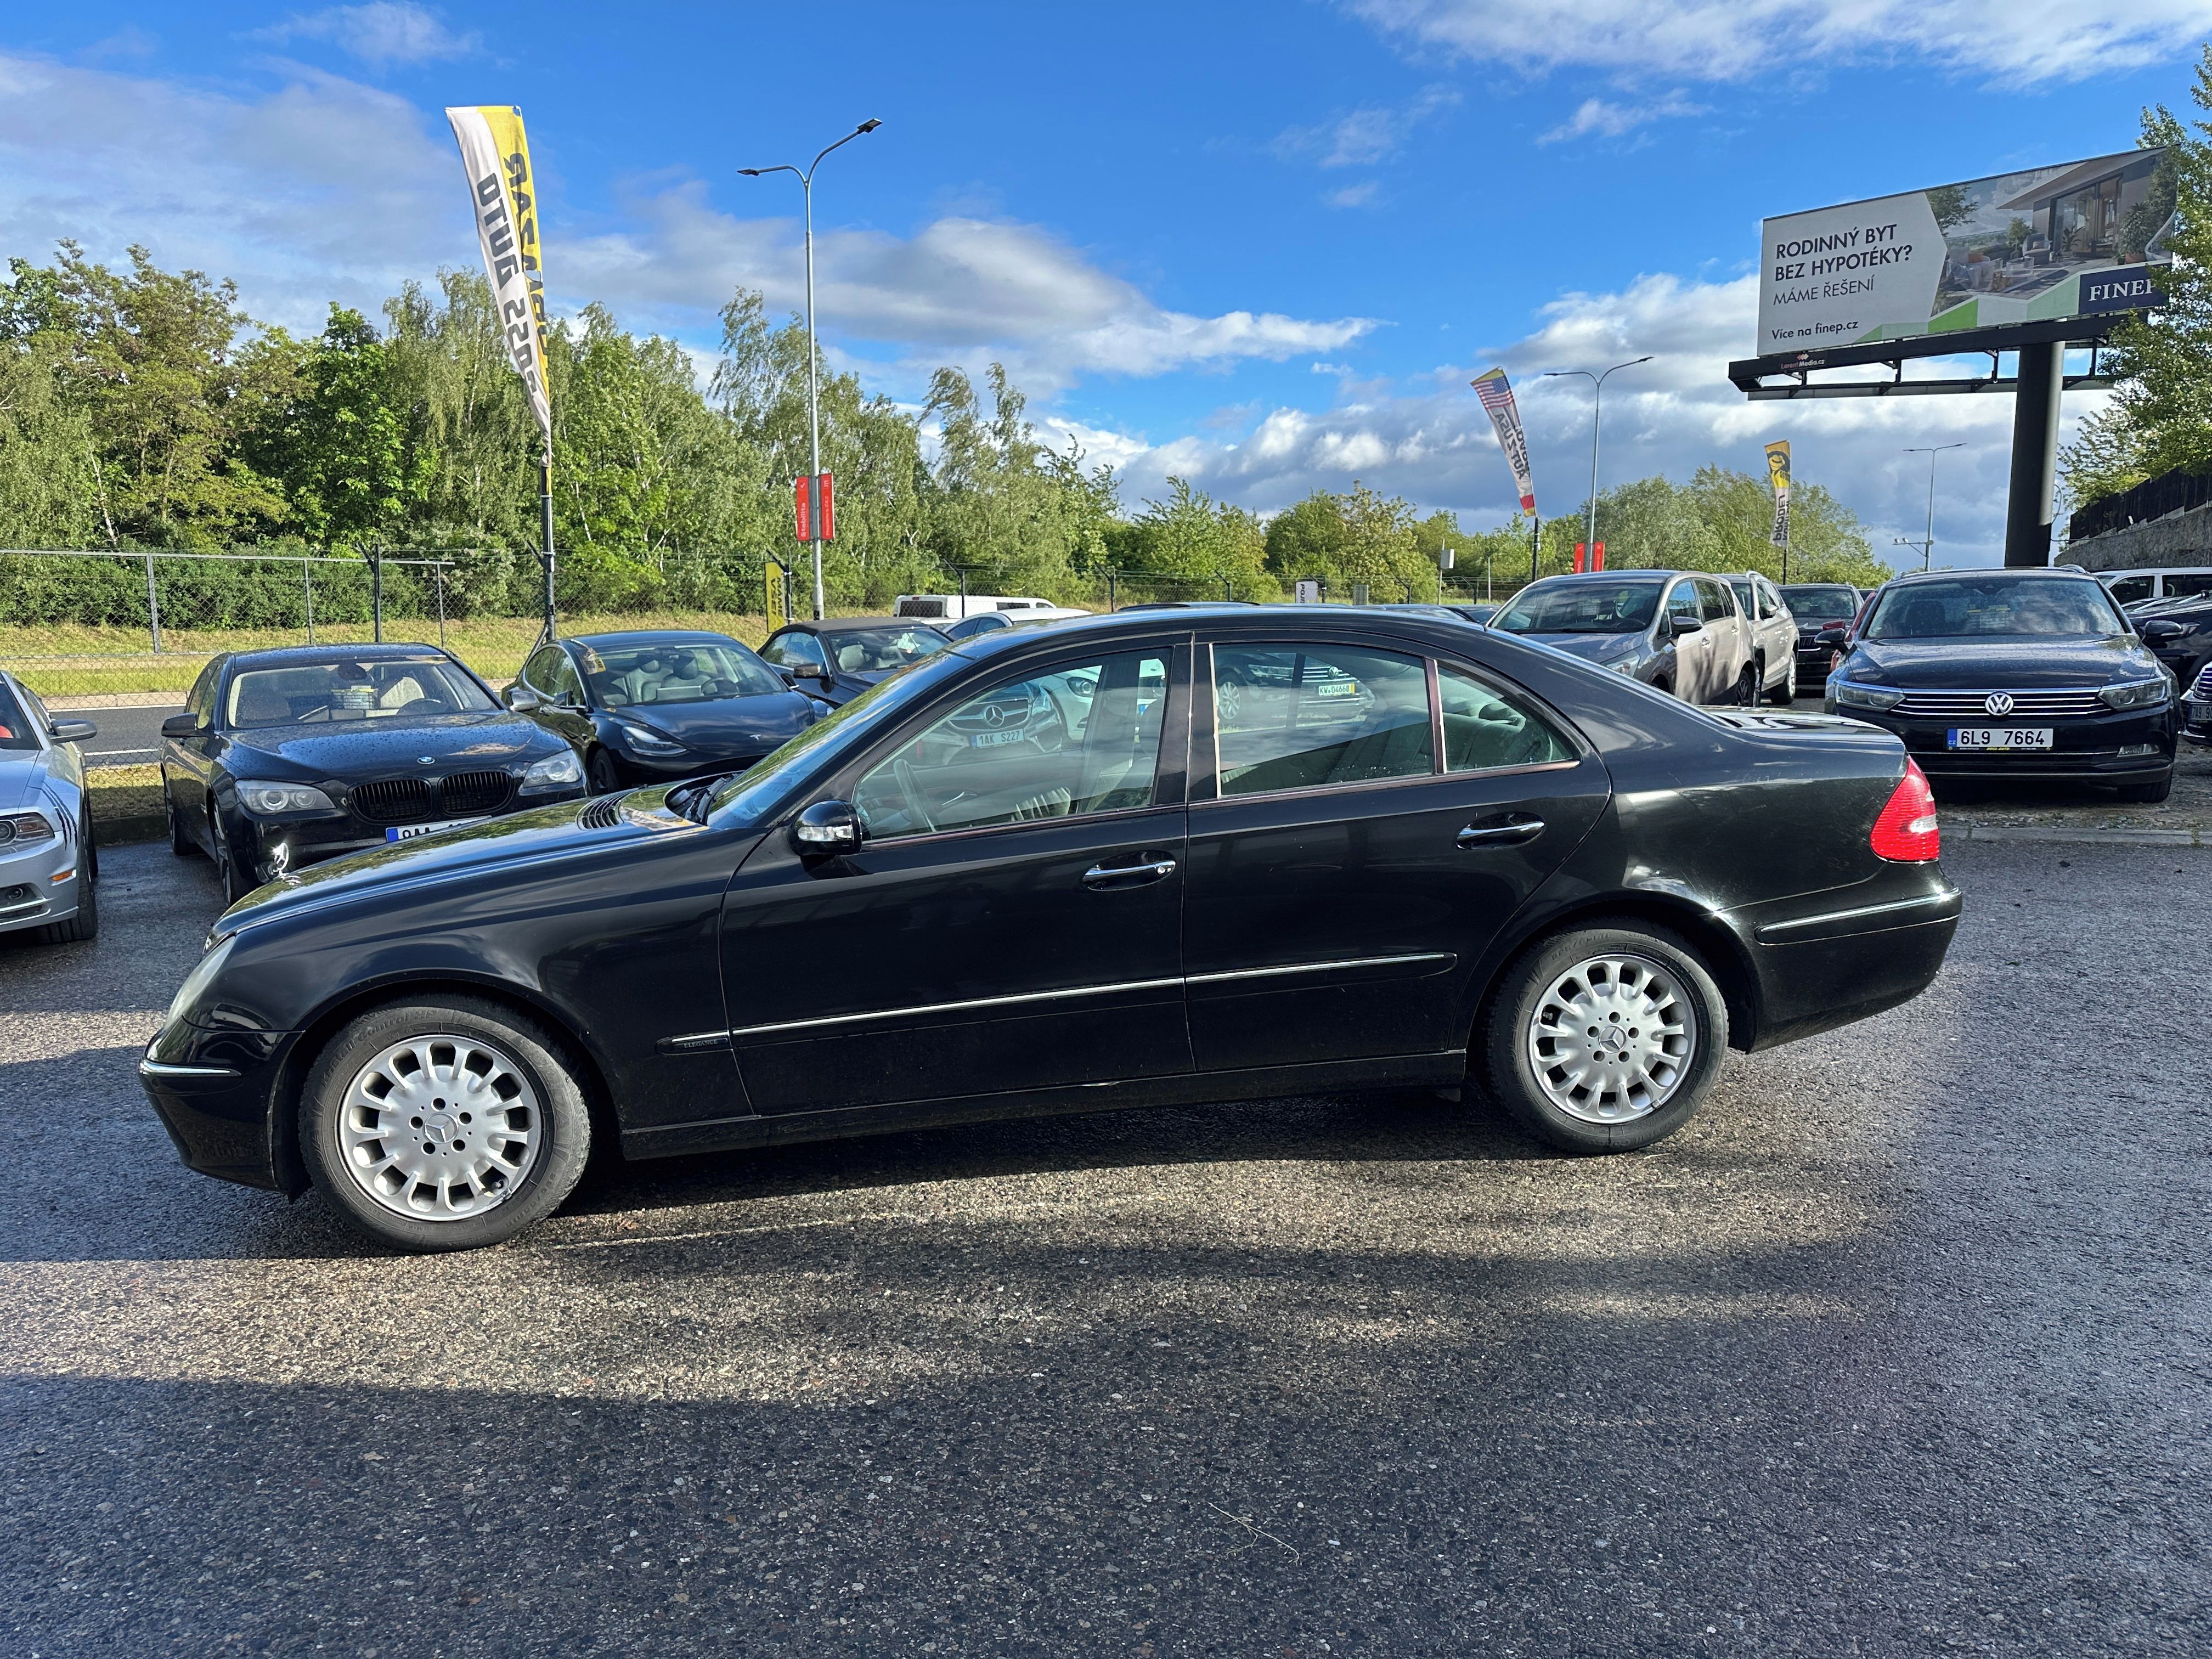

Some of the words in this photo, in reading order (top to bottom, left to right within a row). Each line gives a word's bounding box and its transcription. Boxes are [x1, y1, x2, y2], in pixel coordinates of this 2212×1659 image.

[1776, 226, 1860, 259] RODINNÝ
[1865, 224, 1897, 244] BYT
[1775, 262, 1805, 281] BEZ
[1811, 245, 1912, 276] HYPOTÉKY?
[1773, 287, 1819, 306] MÁME
[1823, 274, 1875, 298] ŘEŠENÍ
[1771, 329, 1794, 340] Více
[1797, 328, 1812, 337] na
[1815, 321, 1859, 334] finep.cz
[979, 734, 995, 745] 1AK
[1001, 731, 1020, 742] S227
[1961, 731, 1990, 745] 6L9
[2004, 730, 2045, 745] 7664
[357, 1013, 411, 1042] Control
[684, 1039, 718, 1048] ELEGANCE
